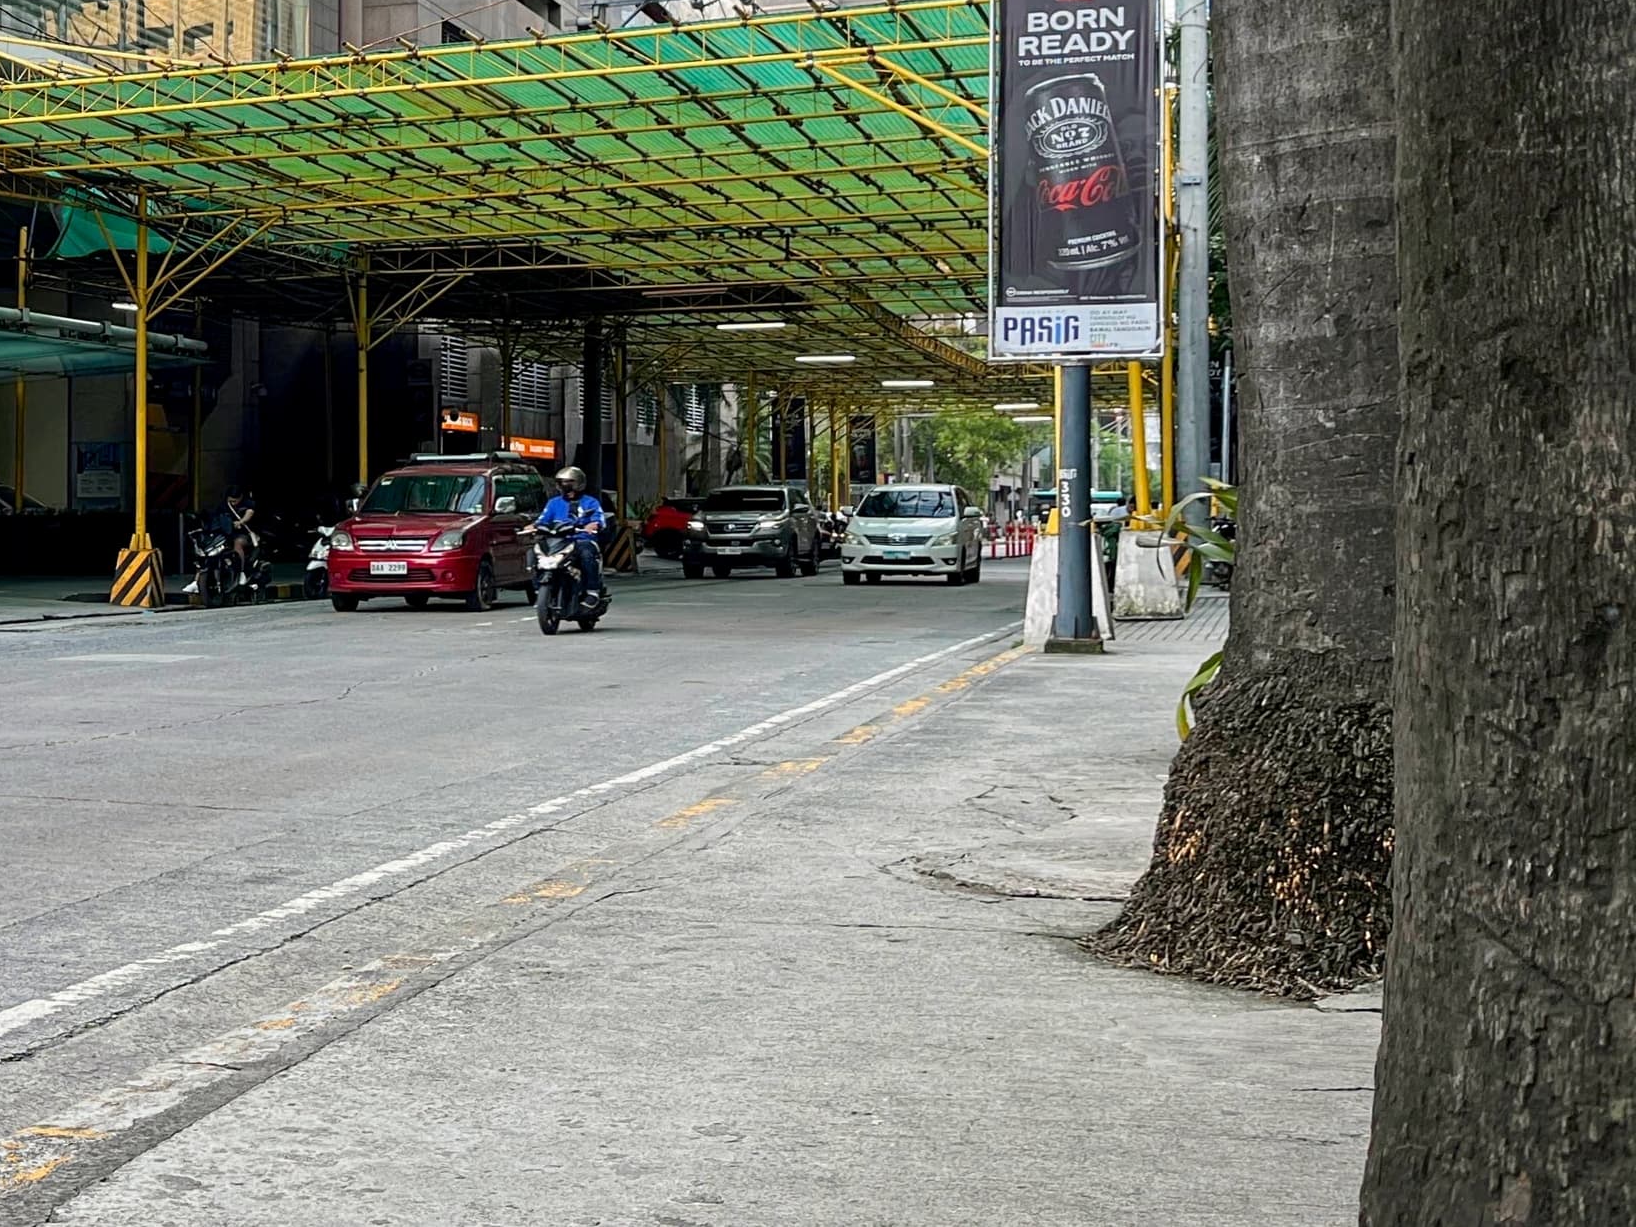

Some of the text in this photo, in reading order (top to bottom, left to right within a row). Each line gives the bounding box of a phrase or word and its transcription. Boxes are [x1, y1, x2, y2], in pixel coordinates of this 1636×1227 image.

[1027, 6, 1125, 33] BORN
[1018, 29, 1135, 57] READY
[1045, 57, 1062, 65] THE
[1064, 55, 1102, 64] PERFECT
[1103, 53, 1135, 61] MATCH
[1056, 138, 1089, 150] BRAND
